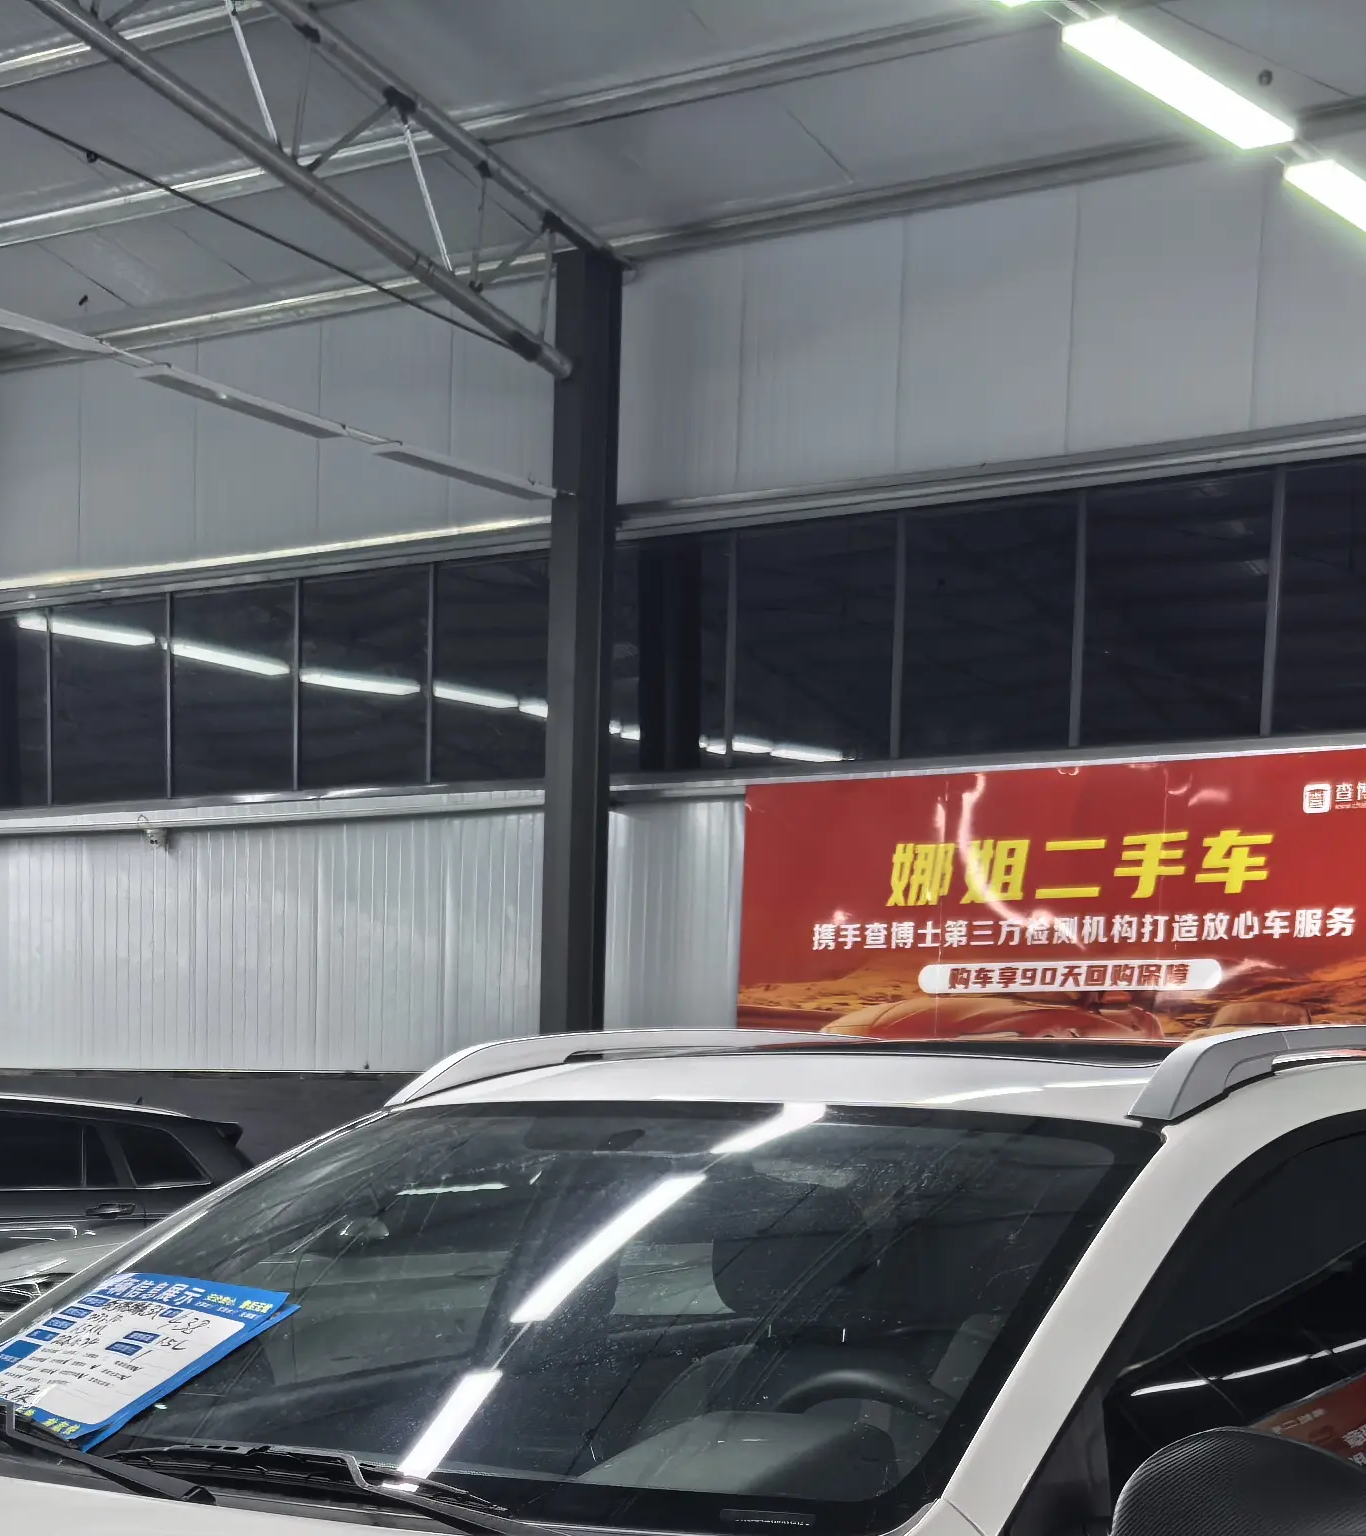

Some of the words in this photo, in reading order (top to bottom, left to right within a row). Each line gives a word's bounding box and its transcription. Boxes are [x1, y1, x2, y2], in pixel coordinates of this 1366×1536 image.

[886, 829, 1275, 908] 娜姐二手车
[812, 907, 1356, 951] 携手查博士第三方检测机构打造放心车服务
[947, 962, 1191, 990] 购车享90天回购保障
